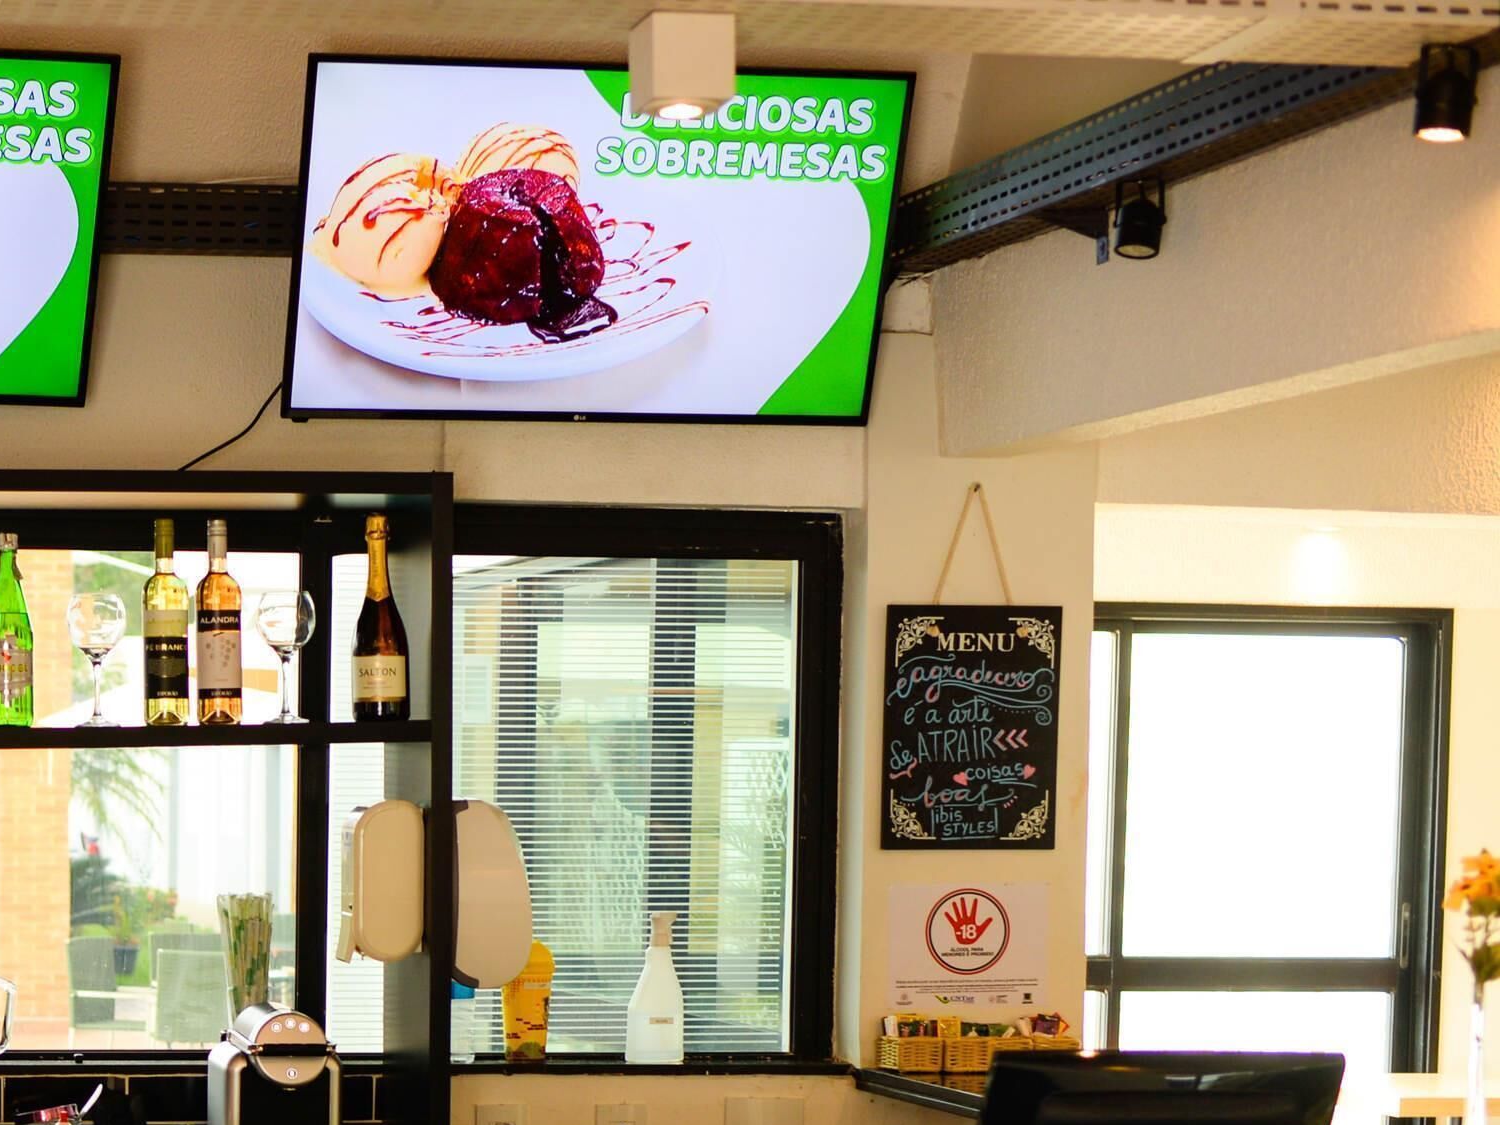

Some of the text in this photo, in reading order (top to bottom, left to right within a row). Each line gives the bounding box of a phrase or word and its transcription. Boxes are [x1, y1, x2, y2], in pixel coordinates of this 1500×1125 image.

[620, 91, 875, 135] DCIOSAS
[594, 137, 888, 181] SOBREMESAS
[200, 616, 239, 624] ALANDRA
[937, 632, 1015, 652] MENU
[359, 667, 397, 678] SALTON
[935, 808, 963, 824] ibis
[943, 820, 995, 836] STYLES
[955, 924, 977, 939] -18
